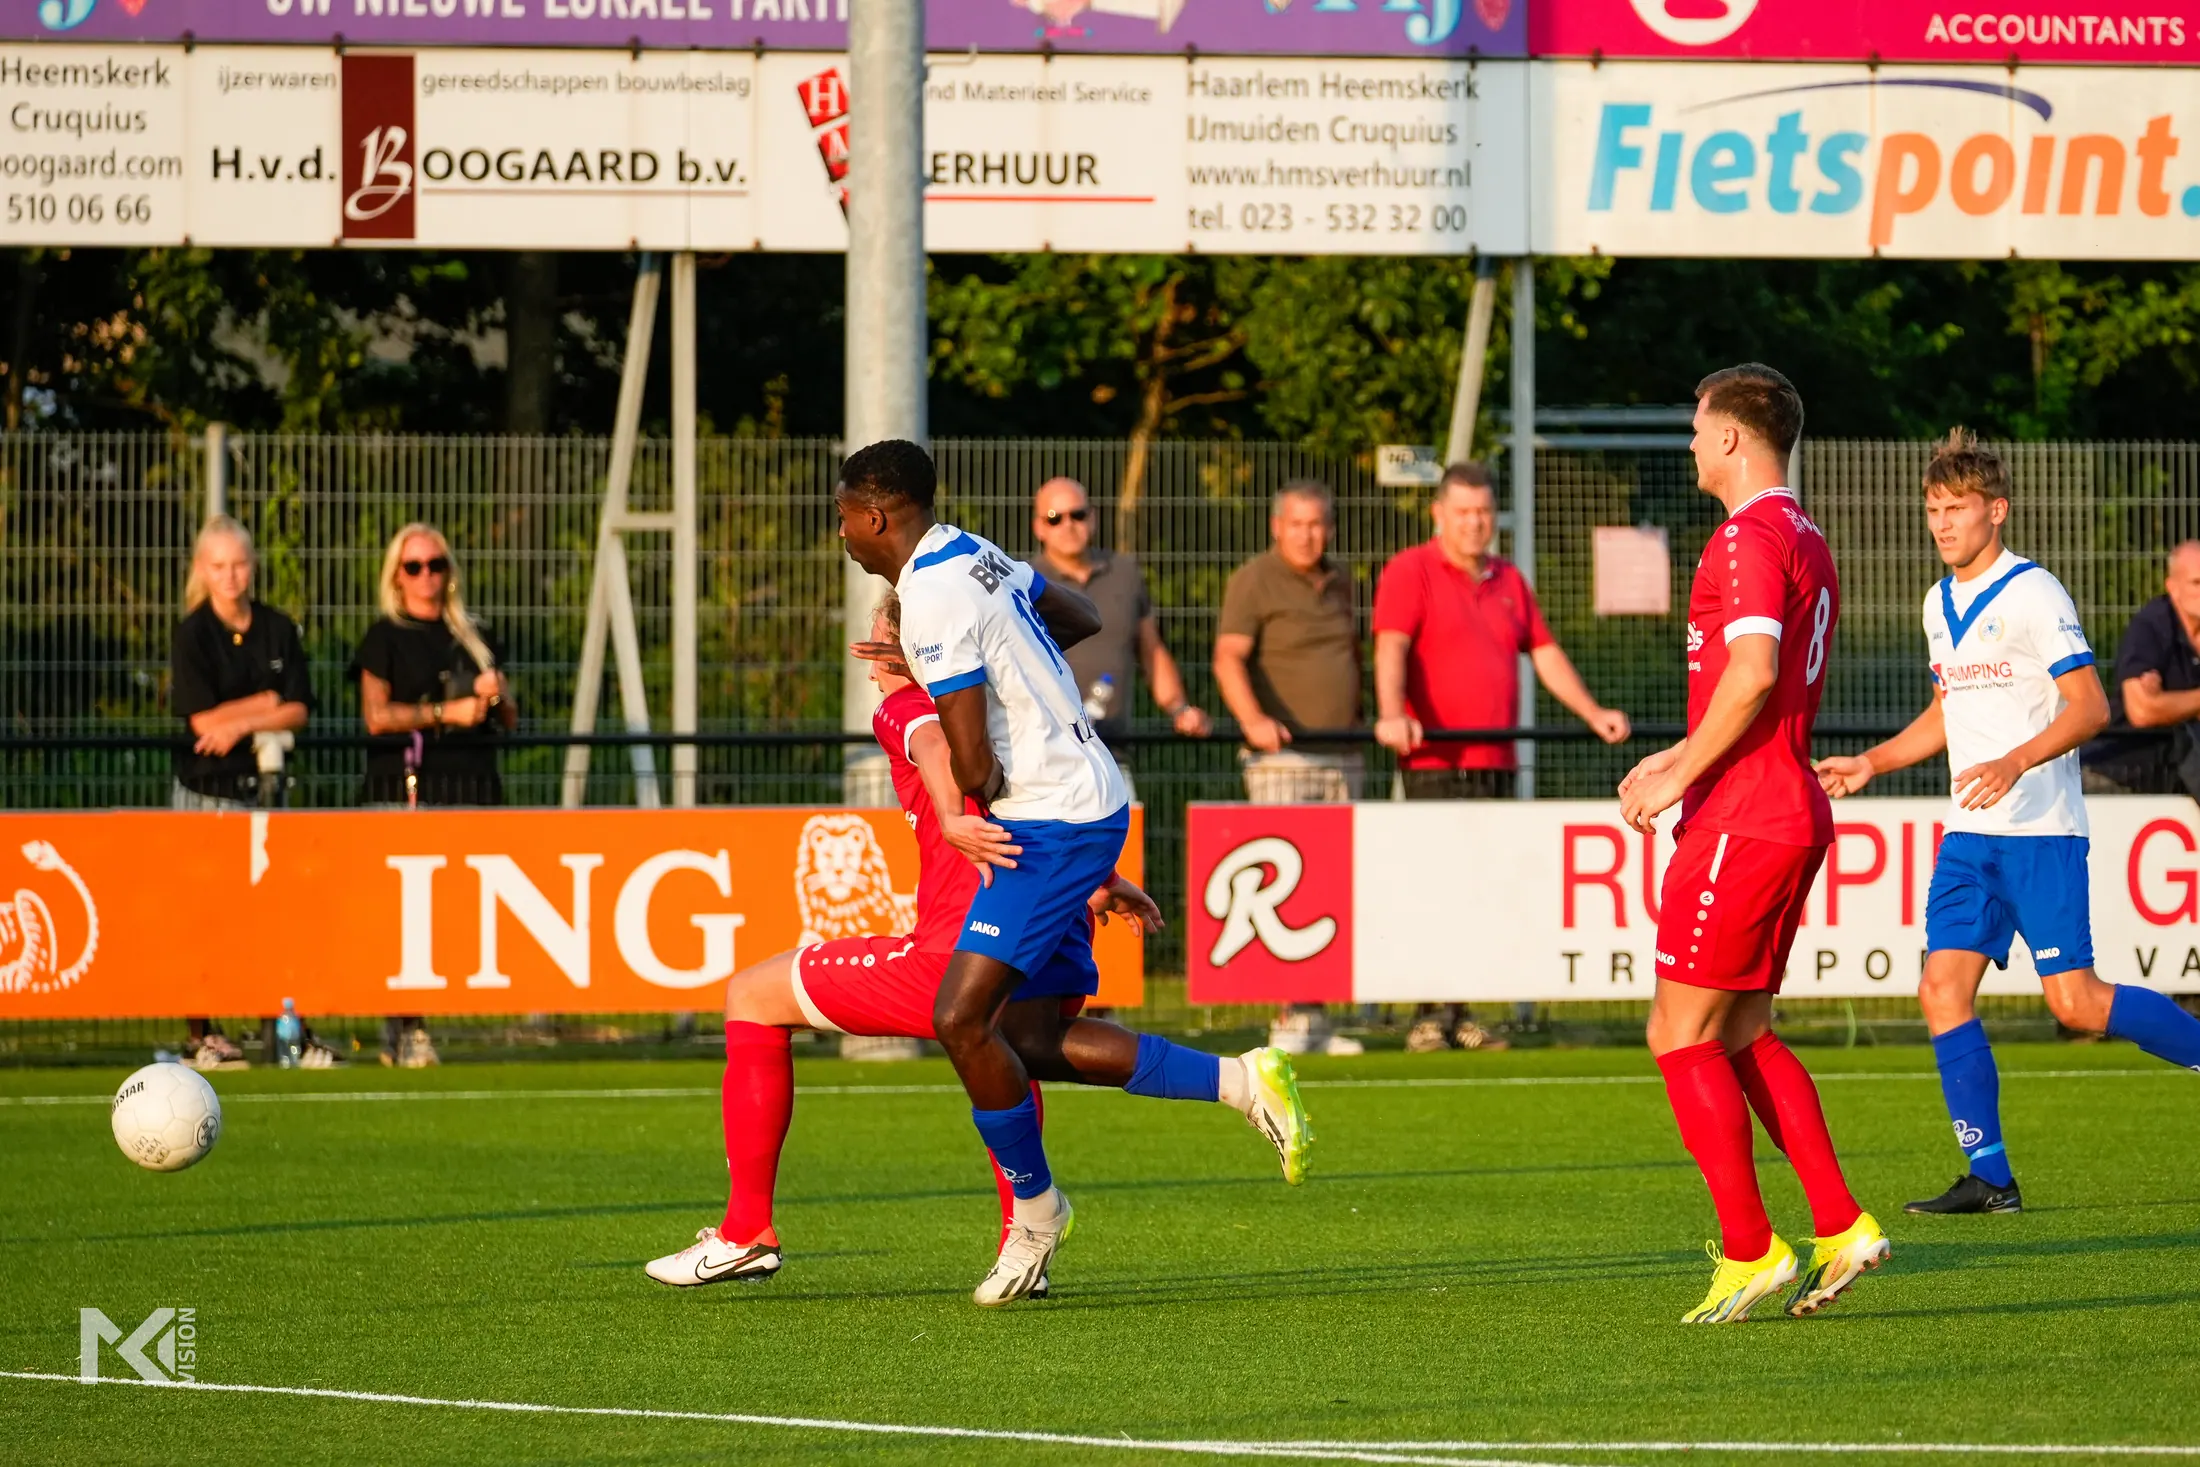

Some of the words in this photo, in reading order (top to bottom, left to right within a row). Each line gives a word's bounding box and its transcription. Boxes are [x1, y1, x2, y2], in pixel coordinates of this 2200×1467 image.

[1925, 13, 2187, 46] ACCOUNTANTS
[0, 56, 171, 88] Heemskerk
[217, 66, 338, 95] ijzerwaren
[421, 71, 608, 96] gereedschappen
[617, 72, 751, 98] bouwbeslag
[1187, 69, 1309, 99] Haarlem
[1319, 71, 1479, 100] Heemskerk
[962, 81, 1067, 102] Materieel
[1074, 82, 1153, 104] Service
[11, 100, 148, 141] Cruquius
[1328, 115, 1459, 155] Cruquius
[0, 146, 183, 187] oogaard.com
[212, 146, 337, 180] H.v.d.
[677, 147, 747, 182] b.v.
[932, 152, 1101, 186] ERHUUR
[1186, 159, 1472, 188] www.hmsverhuur.nl
[8, 193, 56, 224] 510
[69, 193, 104, 224] 06
[116, 193, 152, 224] 66
[1188, 203, 1231, 231] tel.
[1241, 203, 1294, 232] 023
[1327, 204, 1377, 232] 532
[1390, 205, 1421, 232] 32
[1431, 205, 1467, 232] 00
[1806, 586, 1831, 686] 8
[1947, 661, 2013, 682] RUMPING
[386, 849, 746, 991] ING
[970, 920, 1000, 938] JAKO
